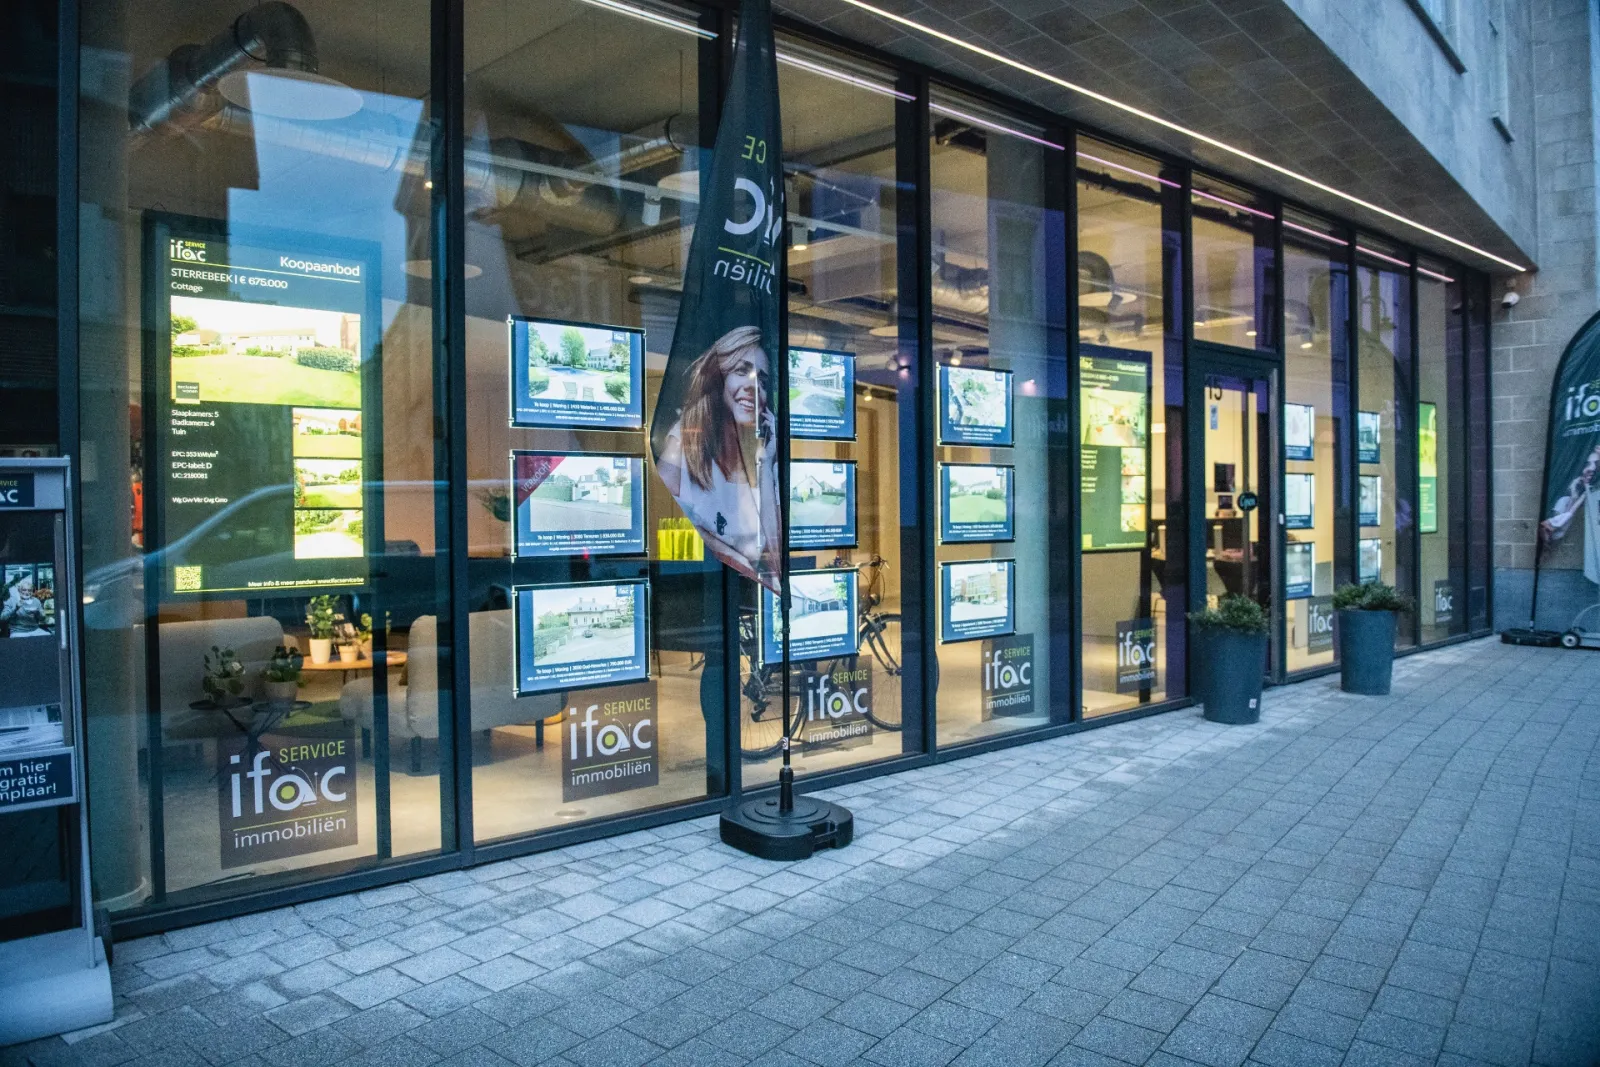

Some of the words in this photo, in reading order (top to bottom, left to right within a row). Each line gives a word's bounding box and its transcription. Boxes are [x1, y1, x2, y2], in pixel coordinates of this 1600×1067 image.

[170, 239, 206, 262] ifac
[184, 240, 206, 249] SERVICE
[280, 256, 361, 277] Koopaanbod
[171, 268, 233, 284] STERREBEEK
[239, 275, 247, 285] €
[248, 277, 288, 289] 675.000
[171, 281, 203, 293] Cottage
[171, 409, 214, 418] Slaapkamers:
[171, 418, 210, 427] Badkamers:
[171, 427, 187, 435] Tuin
[521, 460, 551, 492] VERKOCHT
[1309, 604, 1334, 634] ifac
[1003, 646, 1031, 659] SERVICE
[1119, 631, 1156, 667] ifac
[832, 669, 868, 684] SERVICE
[985, 650, 1031, 691] ifac
[603, 697, 651, 716] SERVICE
[807, 674, 868, 721] ifac
[986, 693, 1031, 709] immobiliën
[569, 704, 652, 761] ifac
[809, 724, 868, 744] immobiliën
[279, 740, 346, 764] SERVICE
[20, 761, 52, 775] hier
[571, 761, 651, 786] immobiliën
[0, 773, 47, 790] gratis
[230, 750, 347, 818] ifac
[234, 816, 346, 849] immobiliën
